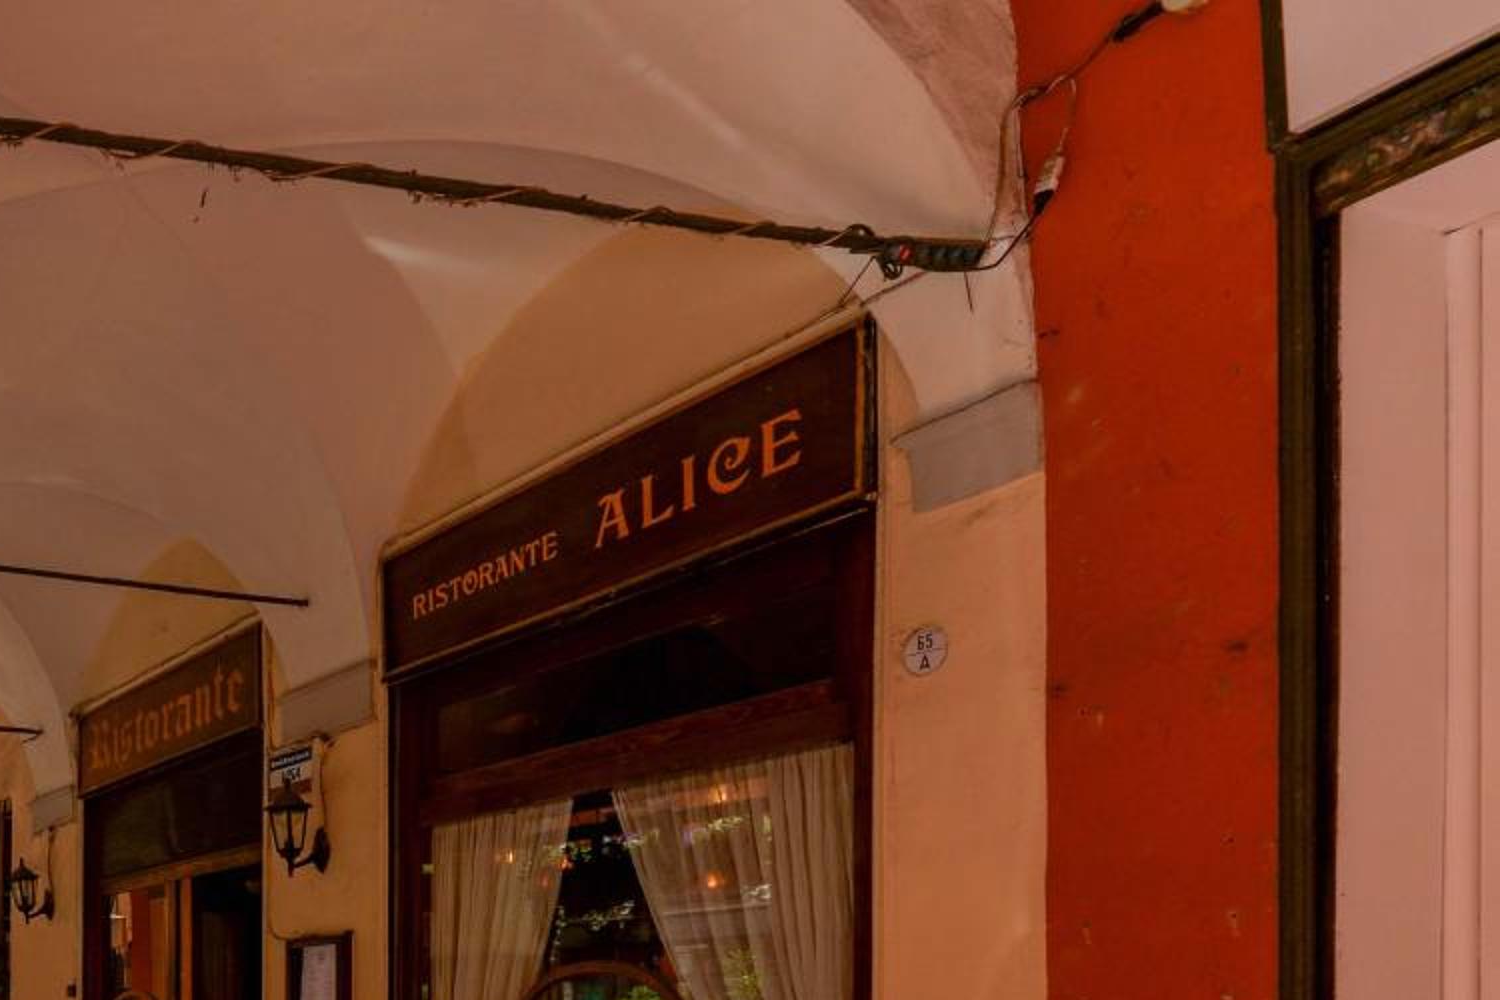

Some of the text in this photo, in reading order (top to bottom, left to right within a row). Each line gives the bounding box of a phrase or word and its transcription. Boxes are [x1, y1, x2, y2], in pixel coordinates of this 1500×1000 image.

[411, 408, 804, 620] RISTORANTE ALICE
[917, 633, 932, 650] 65
[919, 655, 931, 670] A
[90, 657, 245, 769] Ristorante
